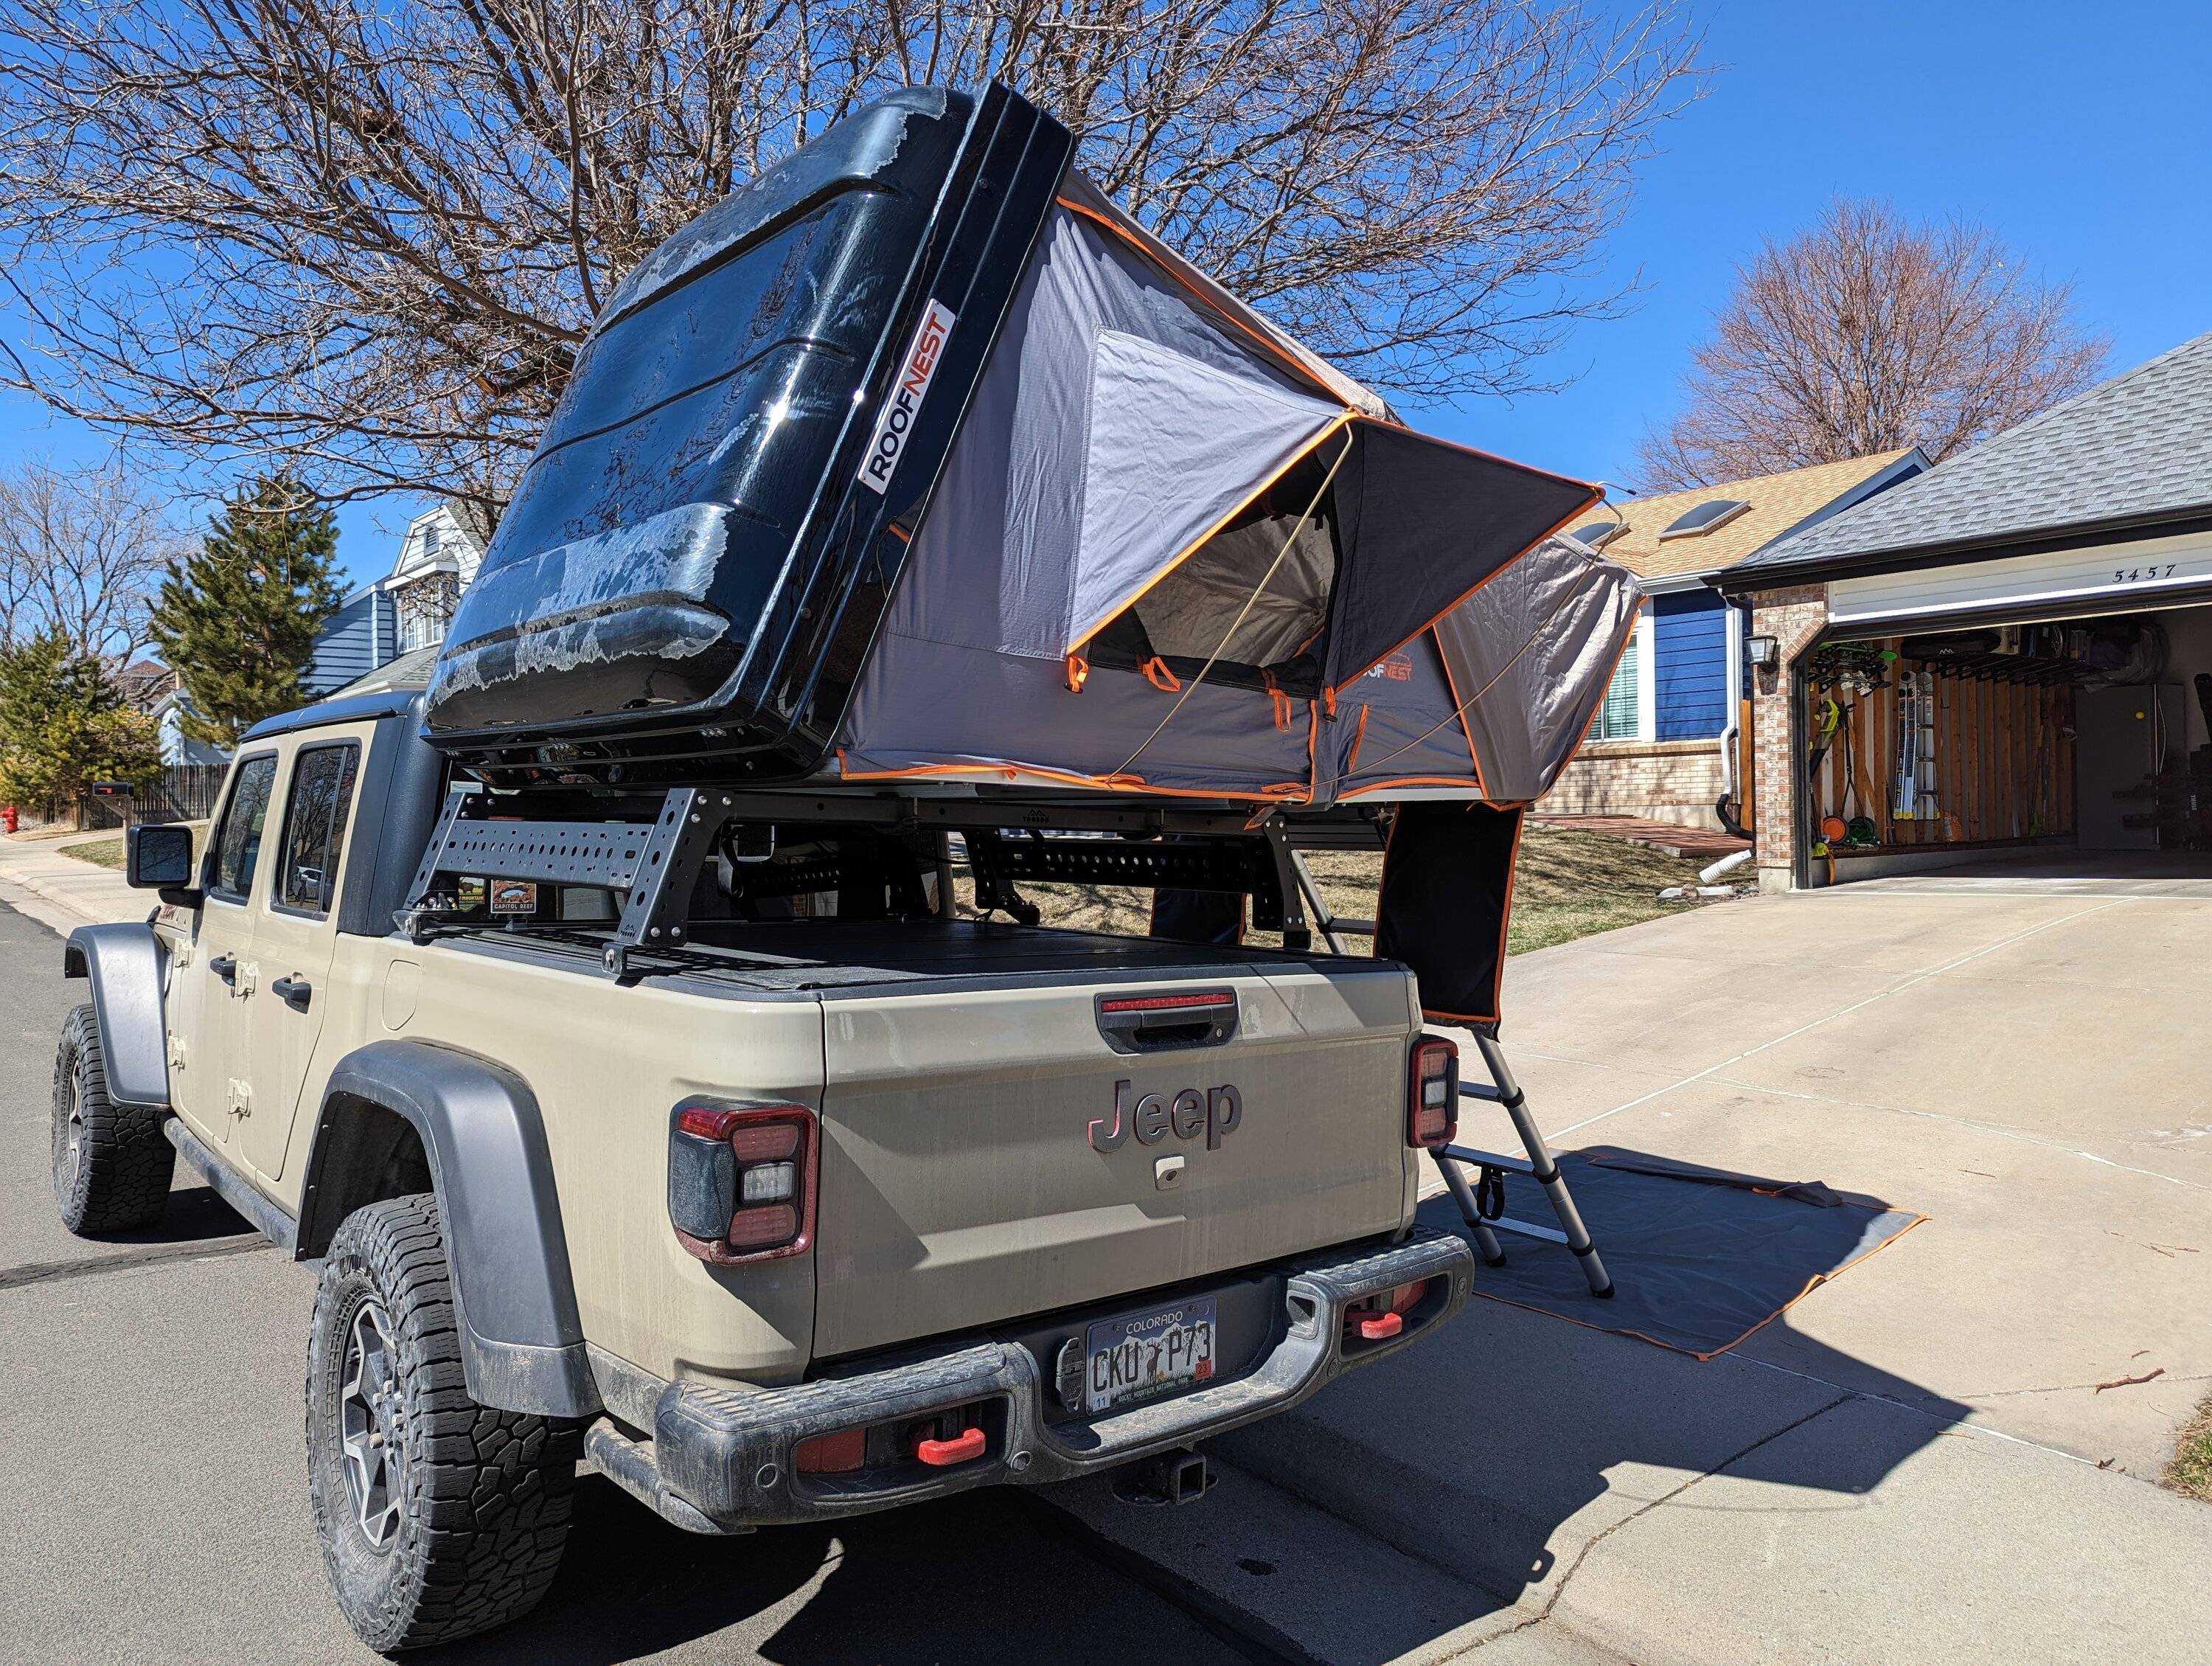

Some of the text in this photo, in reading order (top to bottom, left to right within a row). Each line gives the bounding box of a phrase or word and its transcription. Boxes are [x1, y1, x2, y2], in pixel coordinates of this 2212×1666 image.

[868, 312, 947, 483] ROOFNEST
[2112, 564, 2176, 583] 5457
[1363, 664, 1412, 681] OFNEST
[1087, 1079, 1242, 1153] Jeep
[1126, 1311, 1183, 1334] COLORADO
[1093, 1323, 1211, 1392] CKU P73
[1197, 1364, 1208, 1375] 23
[1096, 1397, 1107, 1408] 11
[1119, 1393, 1131, 1403] ROCKY
[1133, 1386, 1155, 1398] MOUNTAIN
[1156, 1381, 1176, 1392] NATIONAL
